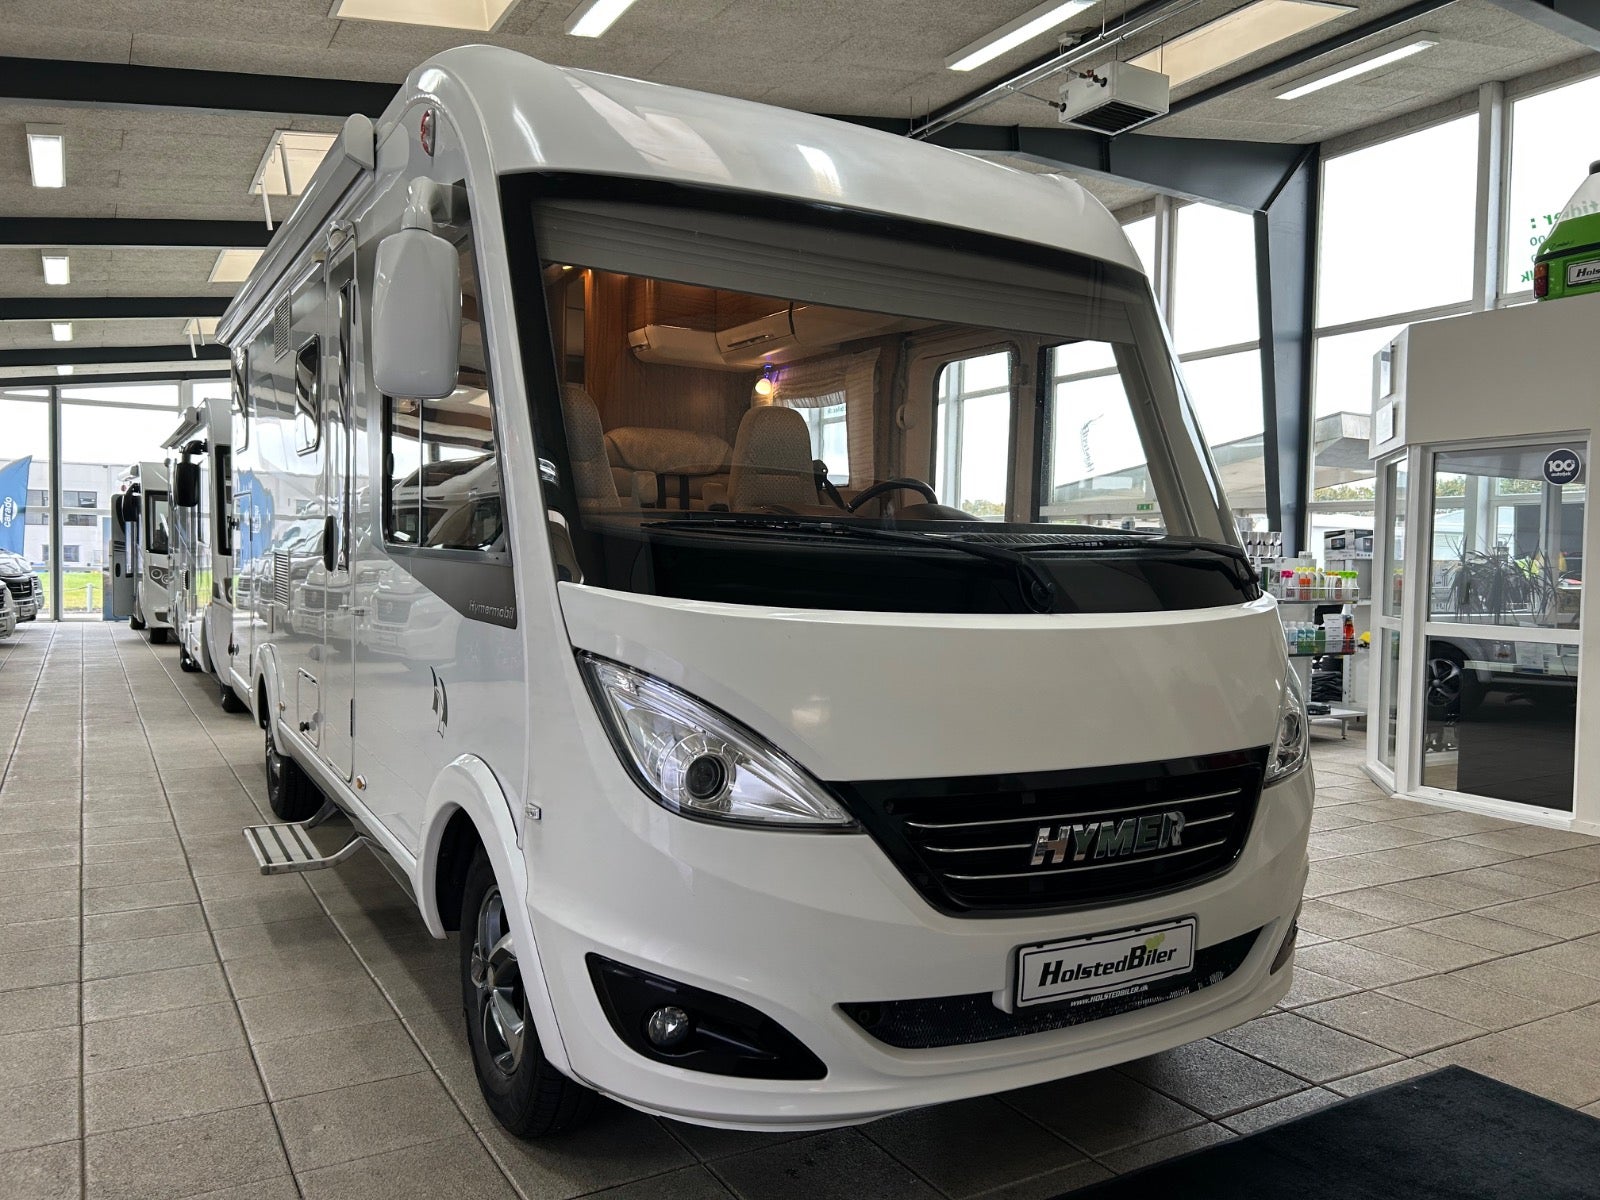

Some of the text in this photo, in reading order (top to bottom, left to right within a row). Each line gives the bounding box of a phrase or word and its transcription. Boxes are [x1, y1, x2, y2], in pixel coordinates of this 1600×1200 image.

[3, 496, 13, 528] carado
[469, 600, 515, 619] Hymermobil
[1030, 811, 1186, 866] HYMER
[1038, 944, 1178, 987] HolstedBiler
